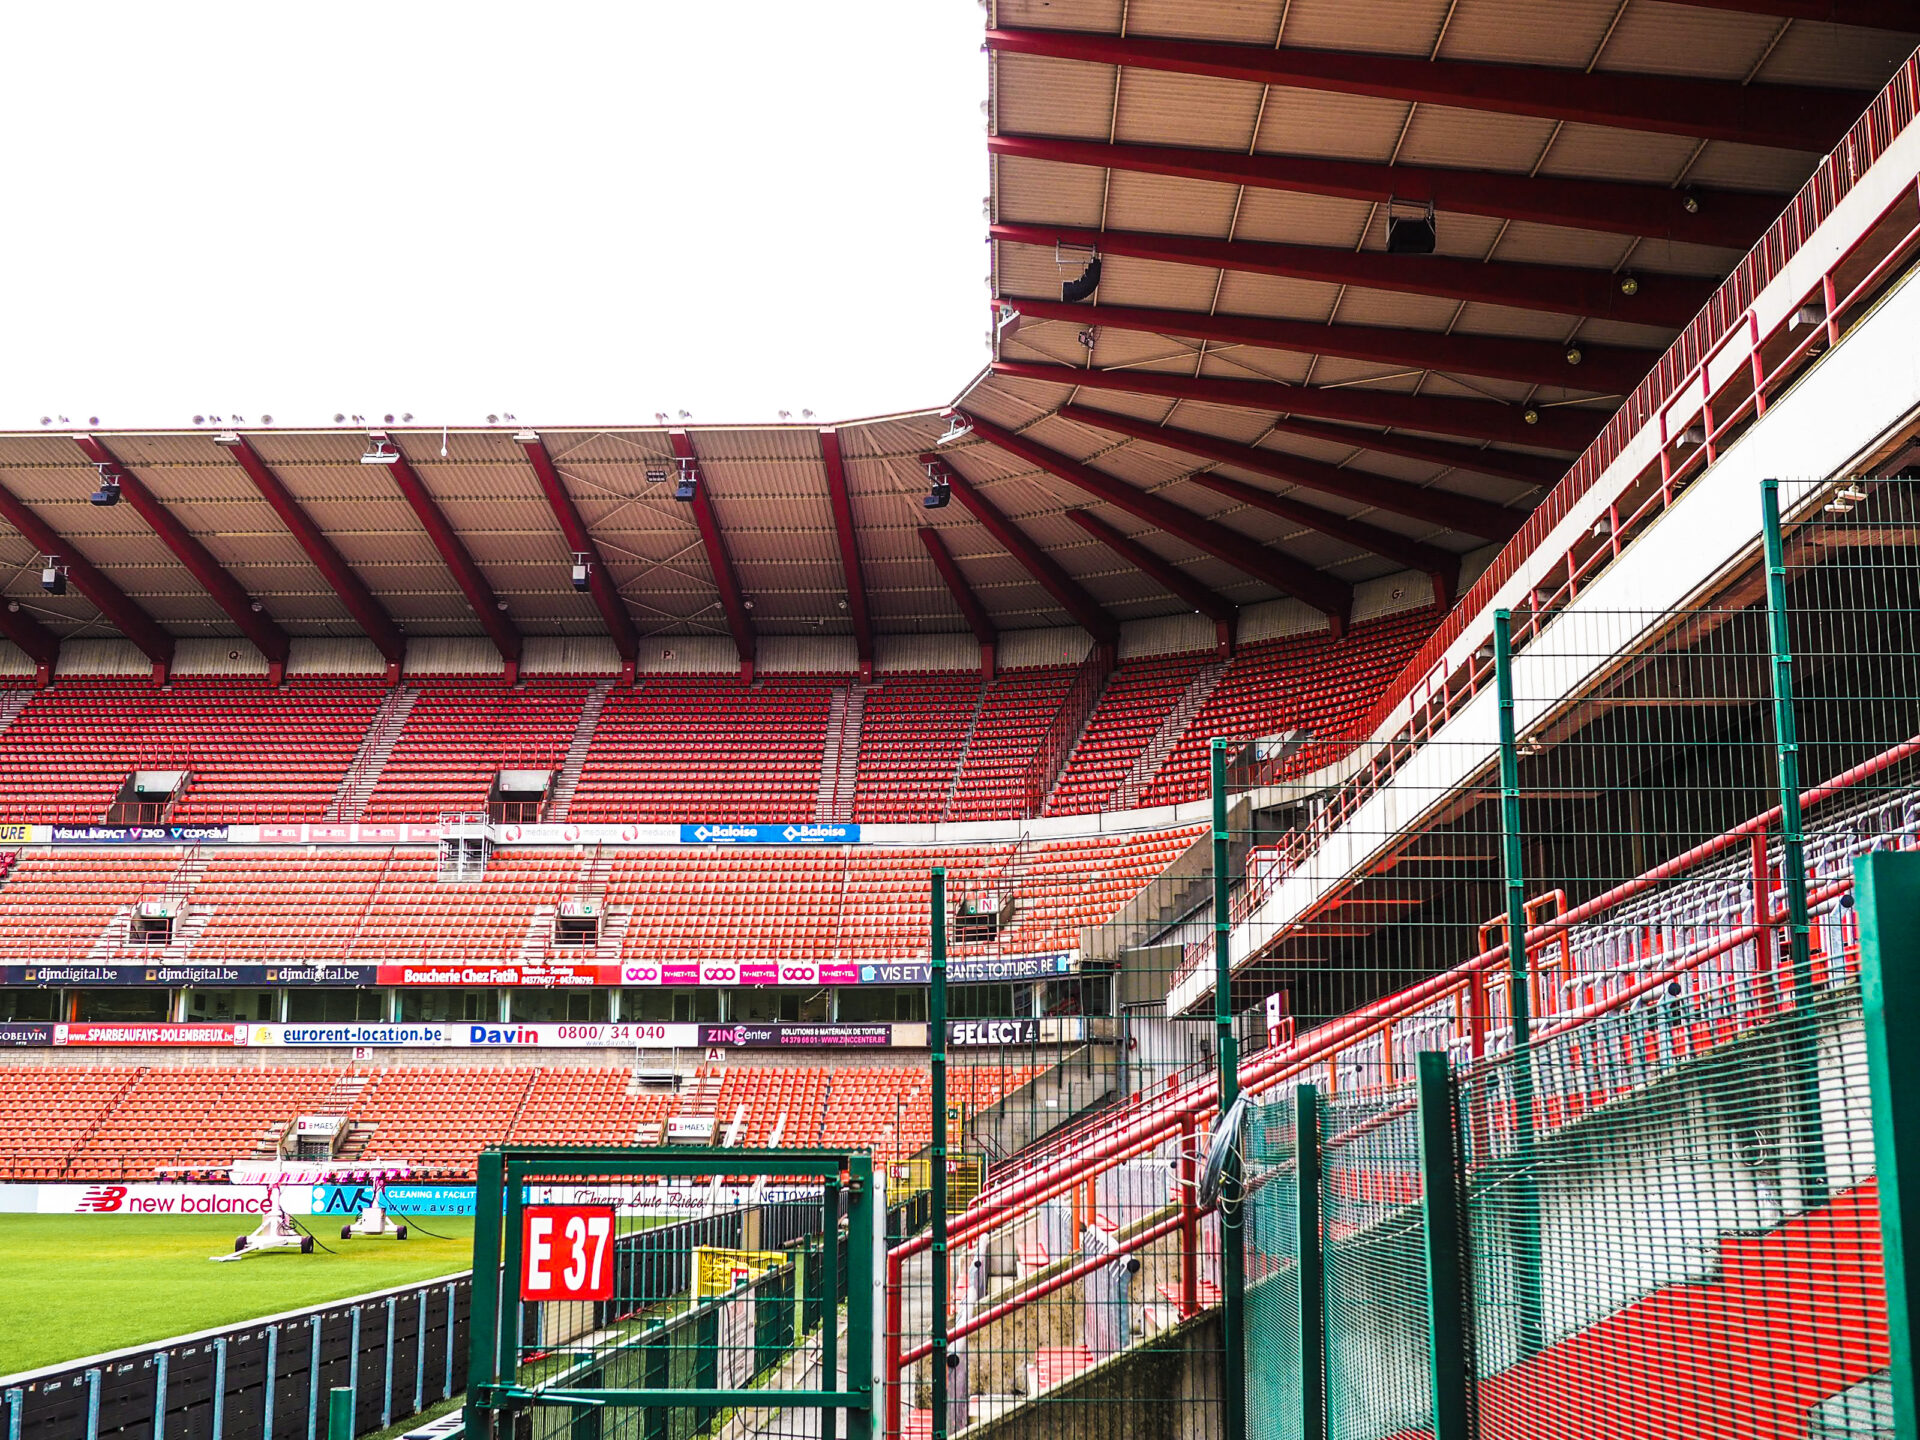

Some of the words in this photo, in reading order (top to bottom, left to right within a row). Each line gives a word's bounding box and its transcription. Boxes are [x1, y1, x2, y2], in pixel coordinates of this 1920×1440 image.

[0, 826, 26, 840] URE
[712, 825, 758, 837] Baloise
[801, 825, 846, 837] Baloise
[38, 968, 118, 982] djmdigital.be
[158, 968, 238, 982] djmdigital.be
[279, 968, 360, 982] djmdigital.be
[404, 969, 460, 983] Boucherie
[461, 969, 489, 983] Chez
[490, 969, 519, 983] Fatih
[882, 967, 902, 981] VIS
[904, 967, 918, 981] ET
[922, 962, 984, 981] VSANTS
[0, 1032, 47, 1041] OBELVIN
[284, 1027, 442, 1041] eurorent-location.be
[470, 1026, 539, 1044] Davin
[558, 1026, 605, 1041] 0800/
[611, 1026, 630, 1040] 34
[636, 1026, 666, 1040] 040
[953, 1022, 1021, 1045] SELECT
[388, 1190, 432, 1200] CLEANING
[435, 1190, 441, 1200] &
[443, 1190, 477, 1200] FACILIT
[129, 1195, 175, 1213] new
[181, 1193, 273, 1213] balance
[388, 1203, 477, 1214] www.avsgr
[527, 1217, 553, 1290] E
[563, 1215, 612, 1290] 37
